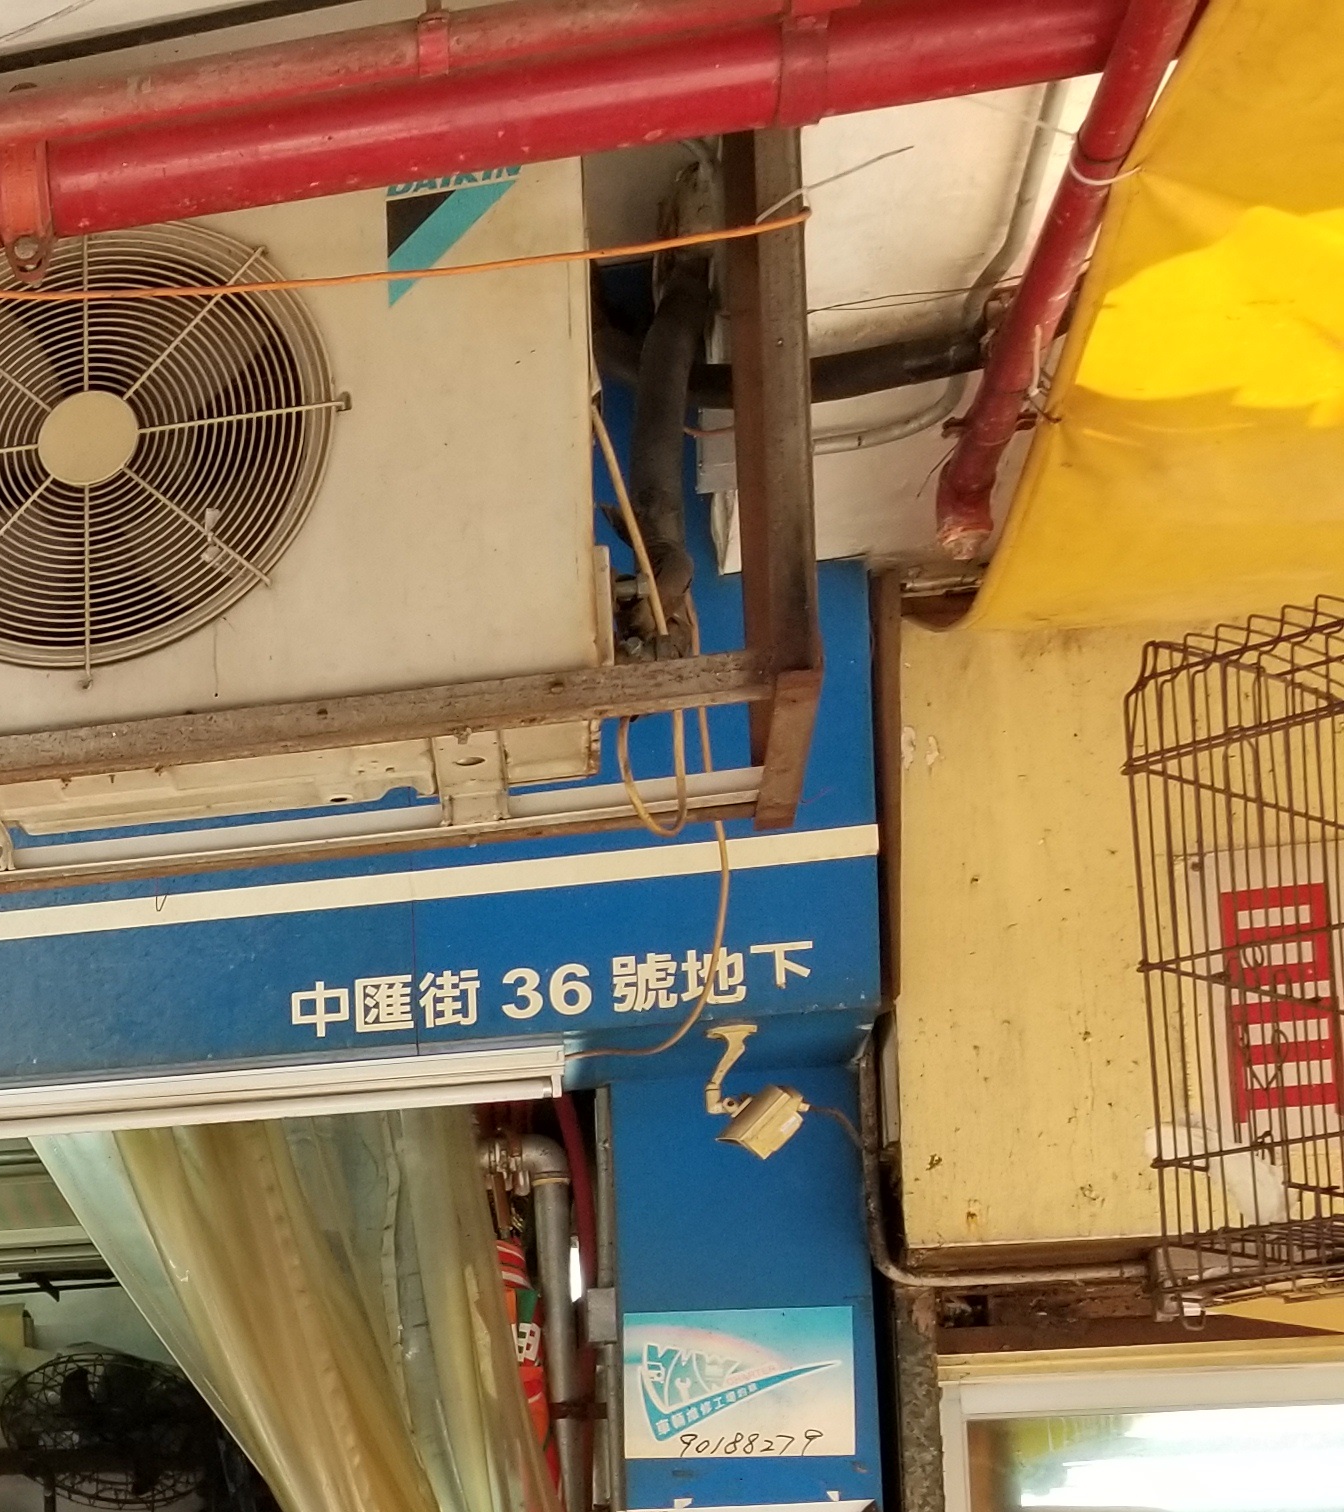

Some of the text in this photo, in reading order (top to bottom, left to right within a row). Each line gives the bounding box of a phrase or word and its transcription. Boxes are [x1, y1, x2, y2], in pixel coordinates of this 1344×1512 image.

[291, 940, 813, 1038] 中匯街 36 號地下
[679, 1429, 825, 1458] 90188279
